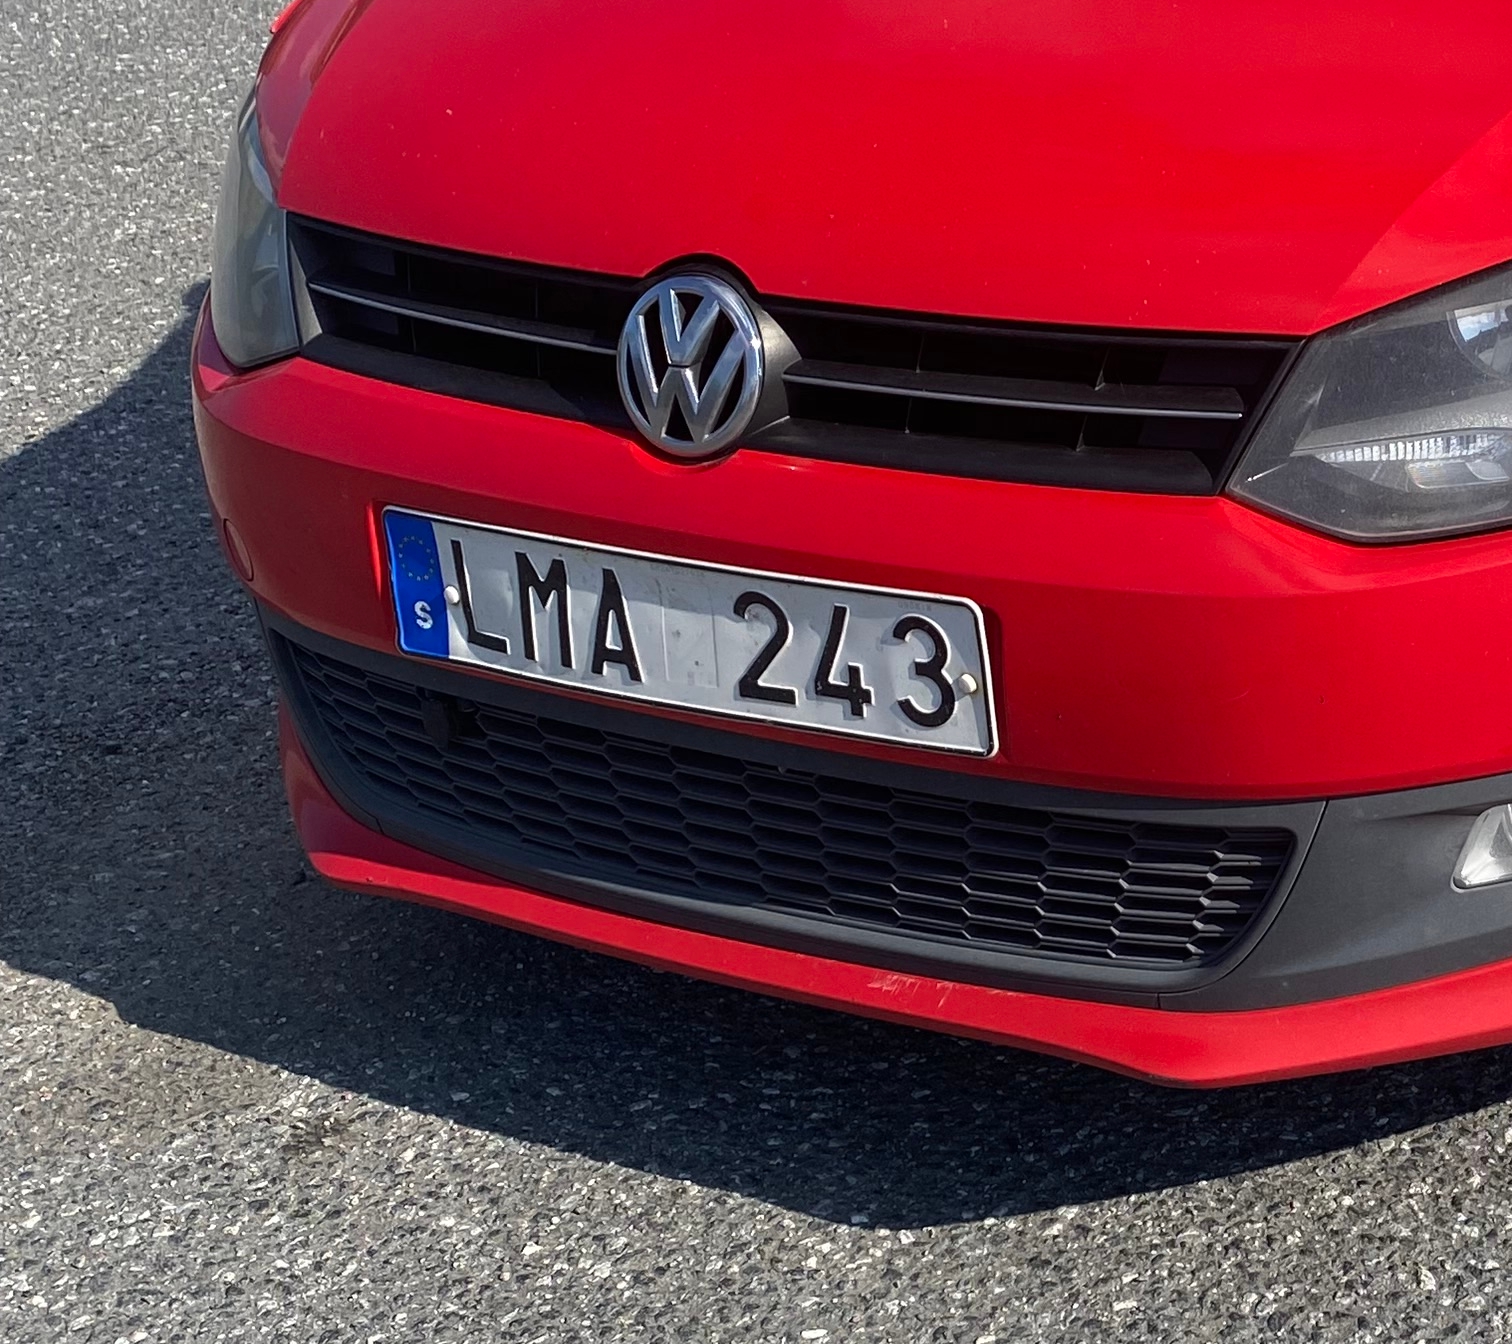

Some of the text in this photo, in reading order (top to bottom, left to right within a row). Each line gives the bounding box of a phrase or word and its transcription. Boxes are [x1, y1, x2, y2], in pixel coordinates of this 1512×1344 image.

[413, 600, 434, 630] S
[451, 539, 956, 727] LMA 243
